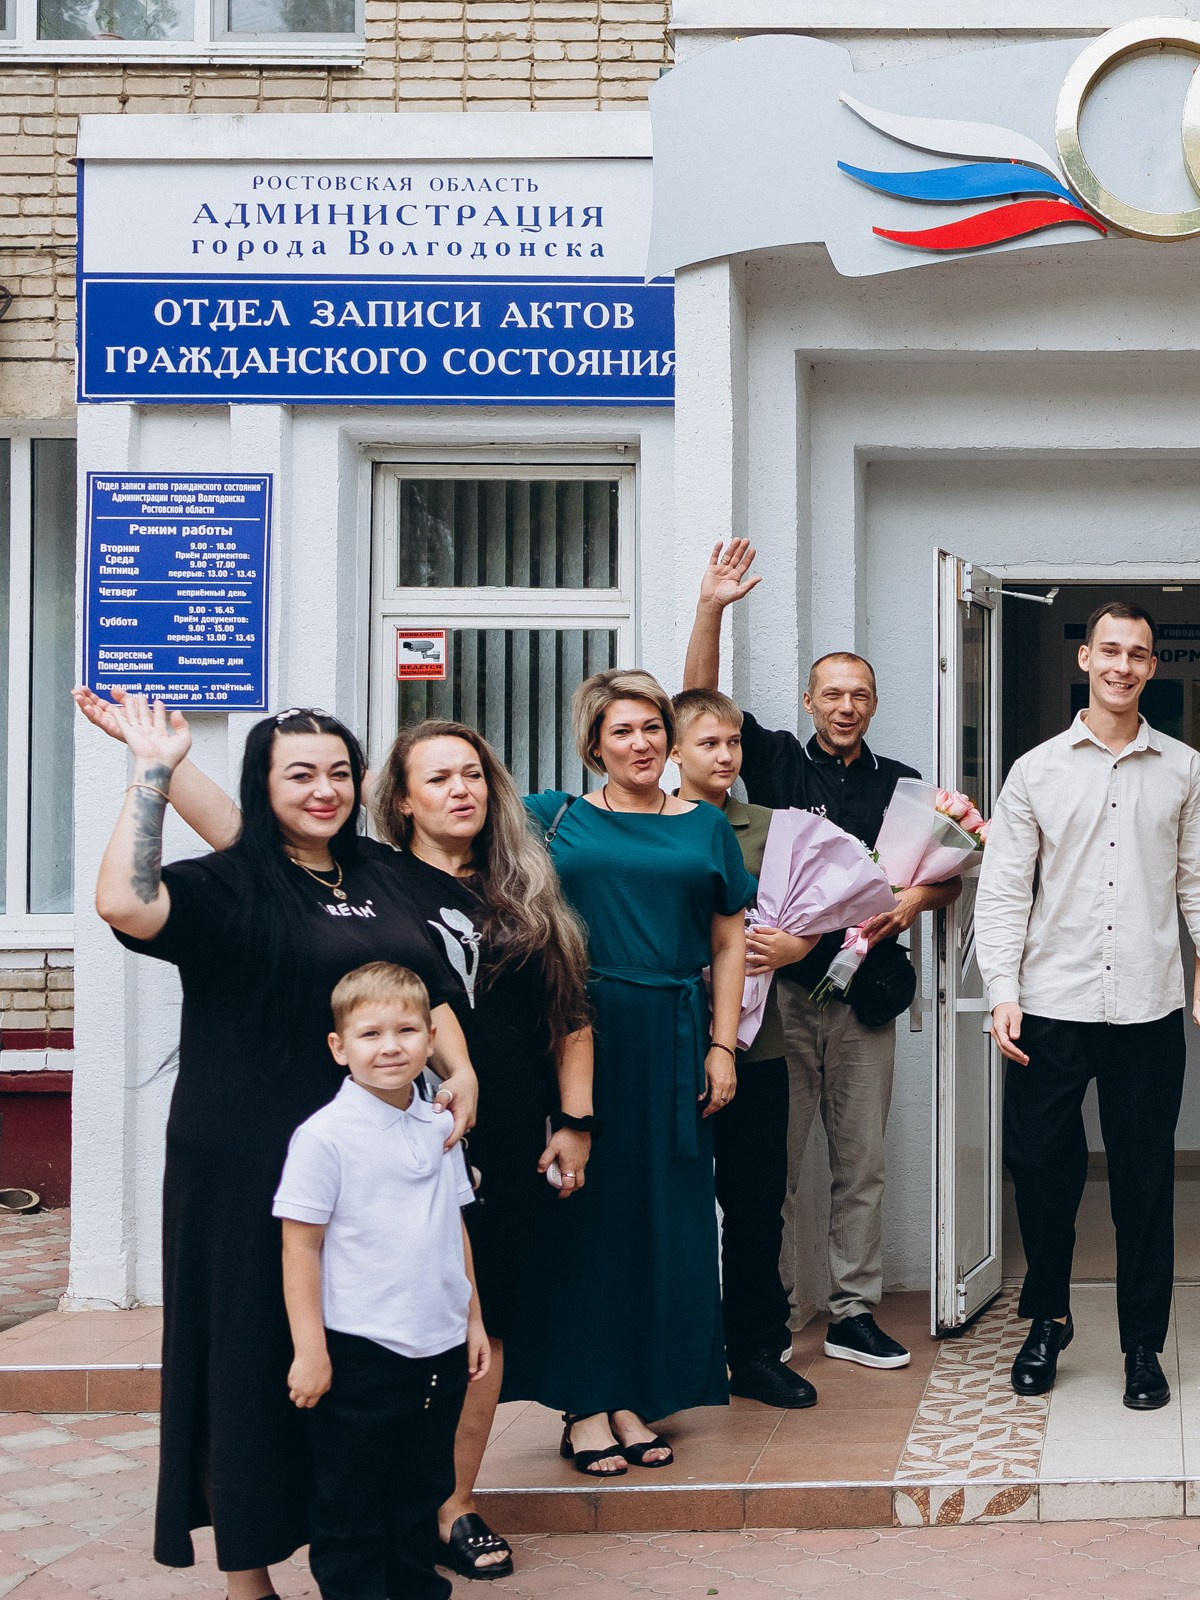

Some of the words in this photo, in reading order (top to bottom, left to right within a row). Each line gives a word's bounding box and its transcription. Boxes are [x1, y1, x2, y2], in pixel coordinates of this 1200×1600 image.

[253, 176, 411, 191] РОСТОВСКАЯ
[430, 178, 538, 192] ОБЛАСТЬ
[192, 203, 603, 234] АДМИНИСТРАЦИЯ
[192, 240, 326, 261] города
[349, 230, 604, 259] Волгодонска
[155, 299, 290, 331] ОТДЕЛ
[311, 301, 480, 327] ЗАПИСИ
[500, 302, 634, 328] АКТОВ
[106, 347, 426, 378] ГРАЖДАНСКОГО
[442, 348, 675, 376] СОСТОЯНИЯ
[96, 482, 118, 491] Отдел
[120, 482, 146, 490] записи
[148, 482, 168, 490] актов
[170, 482, 222, 492] гражданского
[224, 484, 262, 492] состояния
[112, 492, 168, 504] Администрации
[170, 494, 196, 504] города
[198, 492, 246, 504] Волгодонска
[142, 504, 184, 514] Ростовской
[184, 504, 214, 514] области
[130, 524, 176, 536] Режим
[182, 524, 232, 538] работы
[100, 544, 140, 554] Вторник
[190, 542, 208, 550] 9.00
[216, 542, 236, 550] 18.00
[106, 554, 134, 566] Среда
[176, 550, 200, 560] Приём
[202, 552, 250, 560] документов:
[190, 560, 208, 568] 9.00
[216, 560, 236, 568] 17.00
[100, 566, 140, 576] Пятница
[168, 570, 206, 578] перерыв:
[208, 570, 228, 578] 13.00
[236, 570, 256, 578] 13.45
[98, 588, 138, 598] Четверг
[176, 588, 226, 598] неприёмный
[188, 606, 206, 614] 9.00
[100, 616, 138, 628] Суббота
[174, 614, 198, 624] Приём
[200, 616, 248, 624] документов:
[188, 624, 206, 632] 9.00
[214, 624, 234, 632] 15.00
[1164, 628, 1200, 637] города
[166, 634, 204, 642] перерыв:
[206, 634, 226, 642] 13.00
[234, 634, 256, 642] 13.45
[98, 650, 152, 662] Воскресенье
[178, 656, 224, 666] Выходные
[226, 658, 244, 666] дни
[98, 660, 154, 672] Понедельник
[144, 684, 166, 692] день
[168, 684, 200, 692] месяца
[210, 684, 254, 692] отчётный:
[152, 692, 188, 702] граждан
